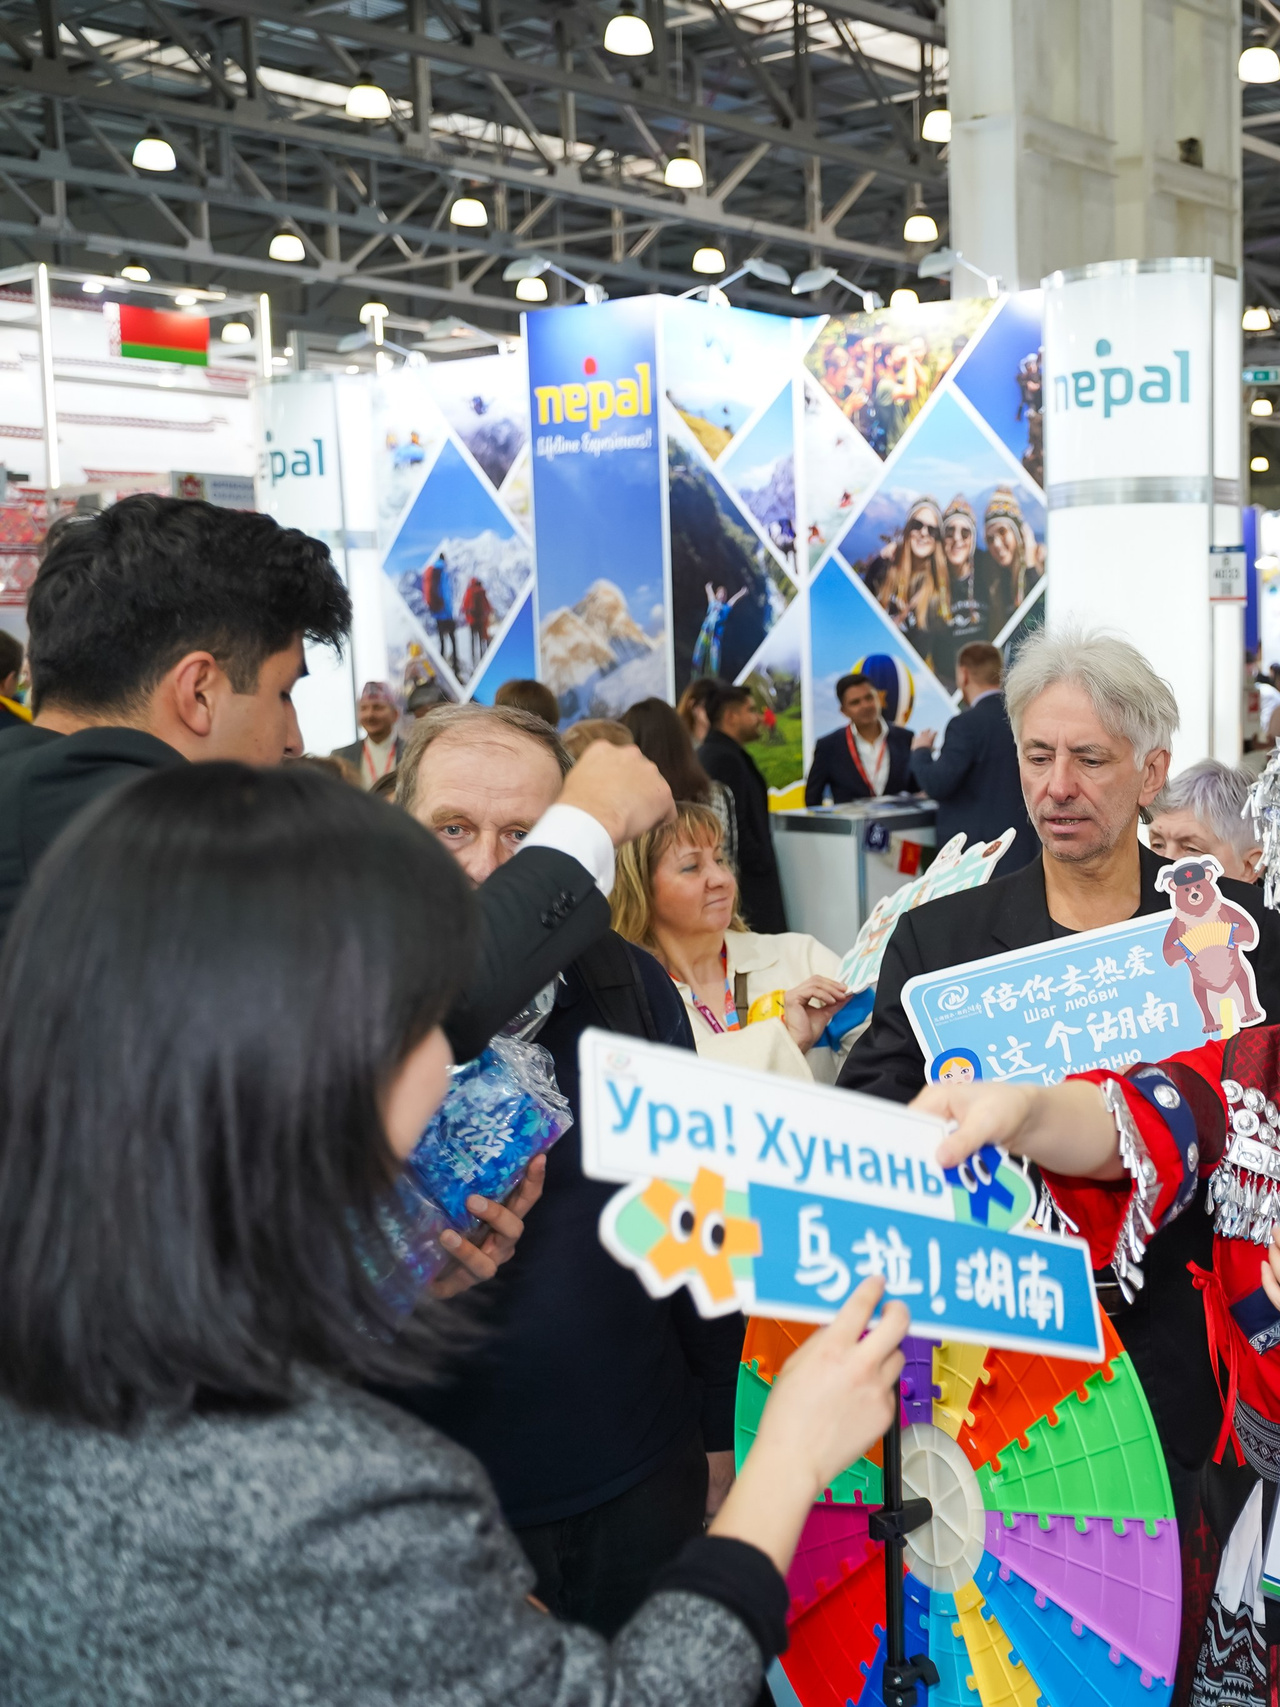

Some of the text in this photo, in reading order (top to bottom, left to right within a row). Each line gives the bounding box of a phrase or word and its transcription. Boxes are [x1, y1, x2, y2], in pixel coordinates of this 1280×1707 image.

[535, 362, 652, 432] nepal
[1054, 350, 1190, 419] nepal
[981, 945, 1156, 1019] 陪你去热爱
[1023, 985, 1119, 1024] Шаг любви
[985, 991, 1180, 1082] 这个湖南
[606, 1077, 945, 1198] Ура! Хунань
